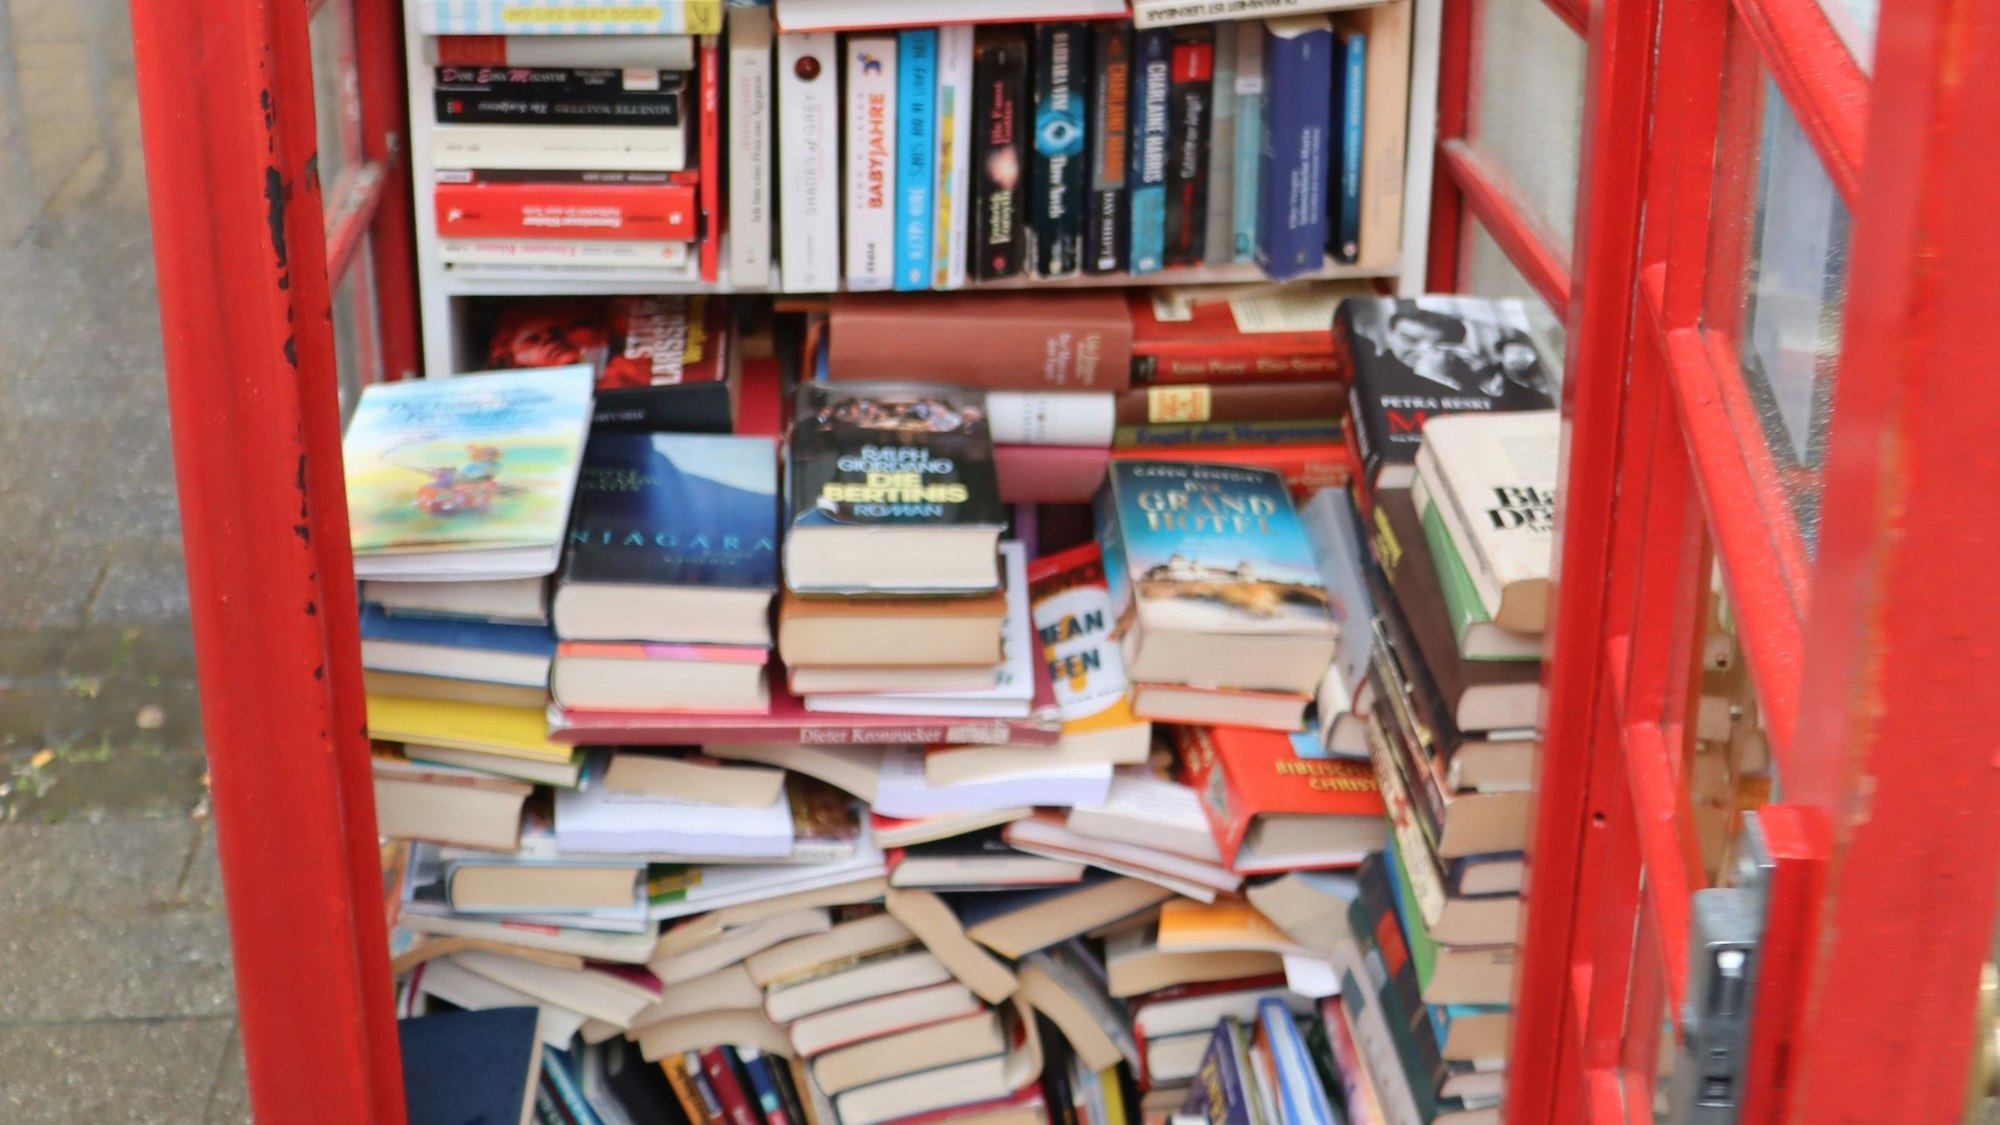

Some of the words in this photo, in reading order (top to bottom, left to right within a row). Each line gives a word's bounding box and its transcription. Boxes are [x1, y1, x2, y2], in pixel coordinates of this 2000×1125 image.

[509, 8, 529, 20] MY
[536, 8, 564, 20] LIFE
[569, 8, 601, 20] NEXT
[608, 8, 653, 20] DOOR
[1052, 32, 1069, 83] BARBARA
[531, 102, 548, 114] The
[554, 103, 611, 115] WALTERS
[613, 103, 671, 115] MINETTE
[1146, 63, 1167, 134] CHARLAINE
[803, 94, 816, 135] GREY
[751, 140, 761, 162] Frau
[868, 93, 888, 209] BABYJAHRE
[1143, 136, 1165, 183] HARRIS
[804, 158, 818, 217] SHADES
[1102, 192, 1114, 215] DAY
[999, 190, 1012, 244] Forsyth
[1380, 396, 1438, 410] PETRA
[861, 446, 929, 462] RALPH
[837, 458, 954, 475] GIORDANO
[866, 472, 923, 489] DIE
[822, 482, 969, 503] BERTINIS
[1137, 488, 1279, 518] GRAND
[854, 503, 944, 517] ROMAN
[569, 529, 775, 552] NIAGARA
[800, 727, 849, 744] Dieter
[851, 727, 942, 745] Kronzucker
